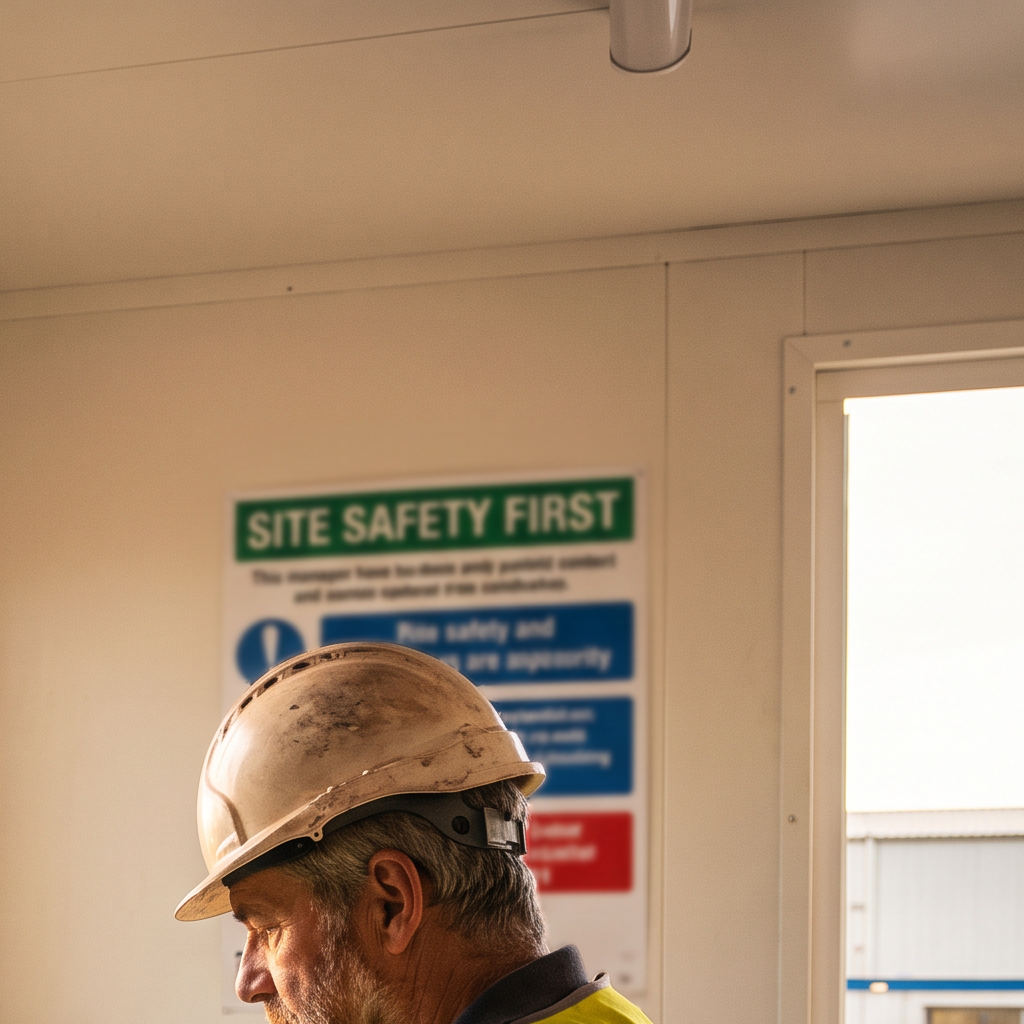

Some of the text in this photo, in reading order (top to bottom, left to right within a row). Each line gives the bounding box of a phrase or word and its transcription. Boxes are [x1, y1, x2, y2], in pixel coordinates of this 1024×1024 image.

[247, 491, 621, 549] SITE SAFETY FIRST
[445, 617, 510, 645] safety
[515, 616, 556, 640] and
